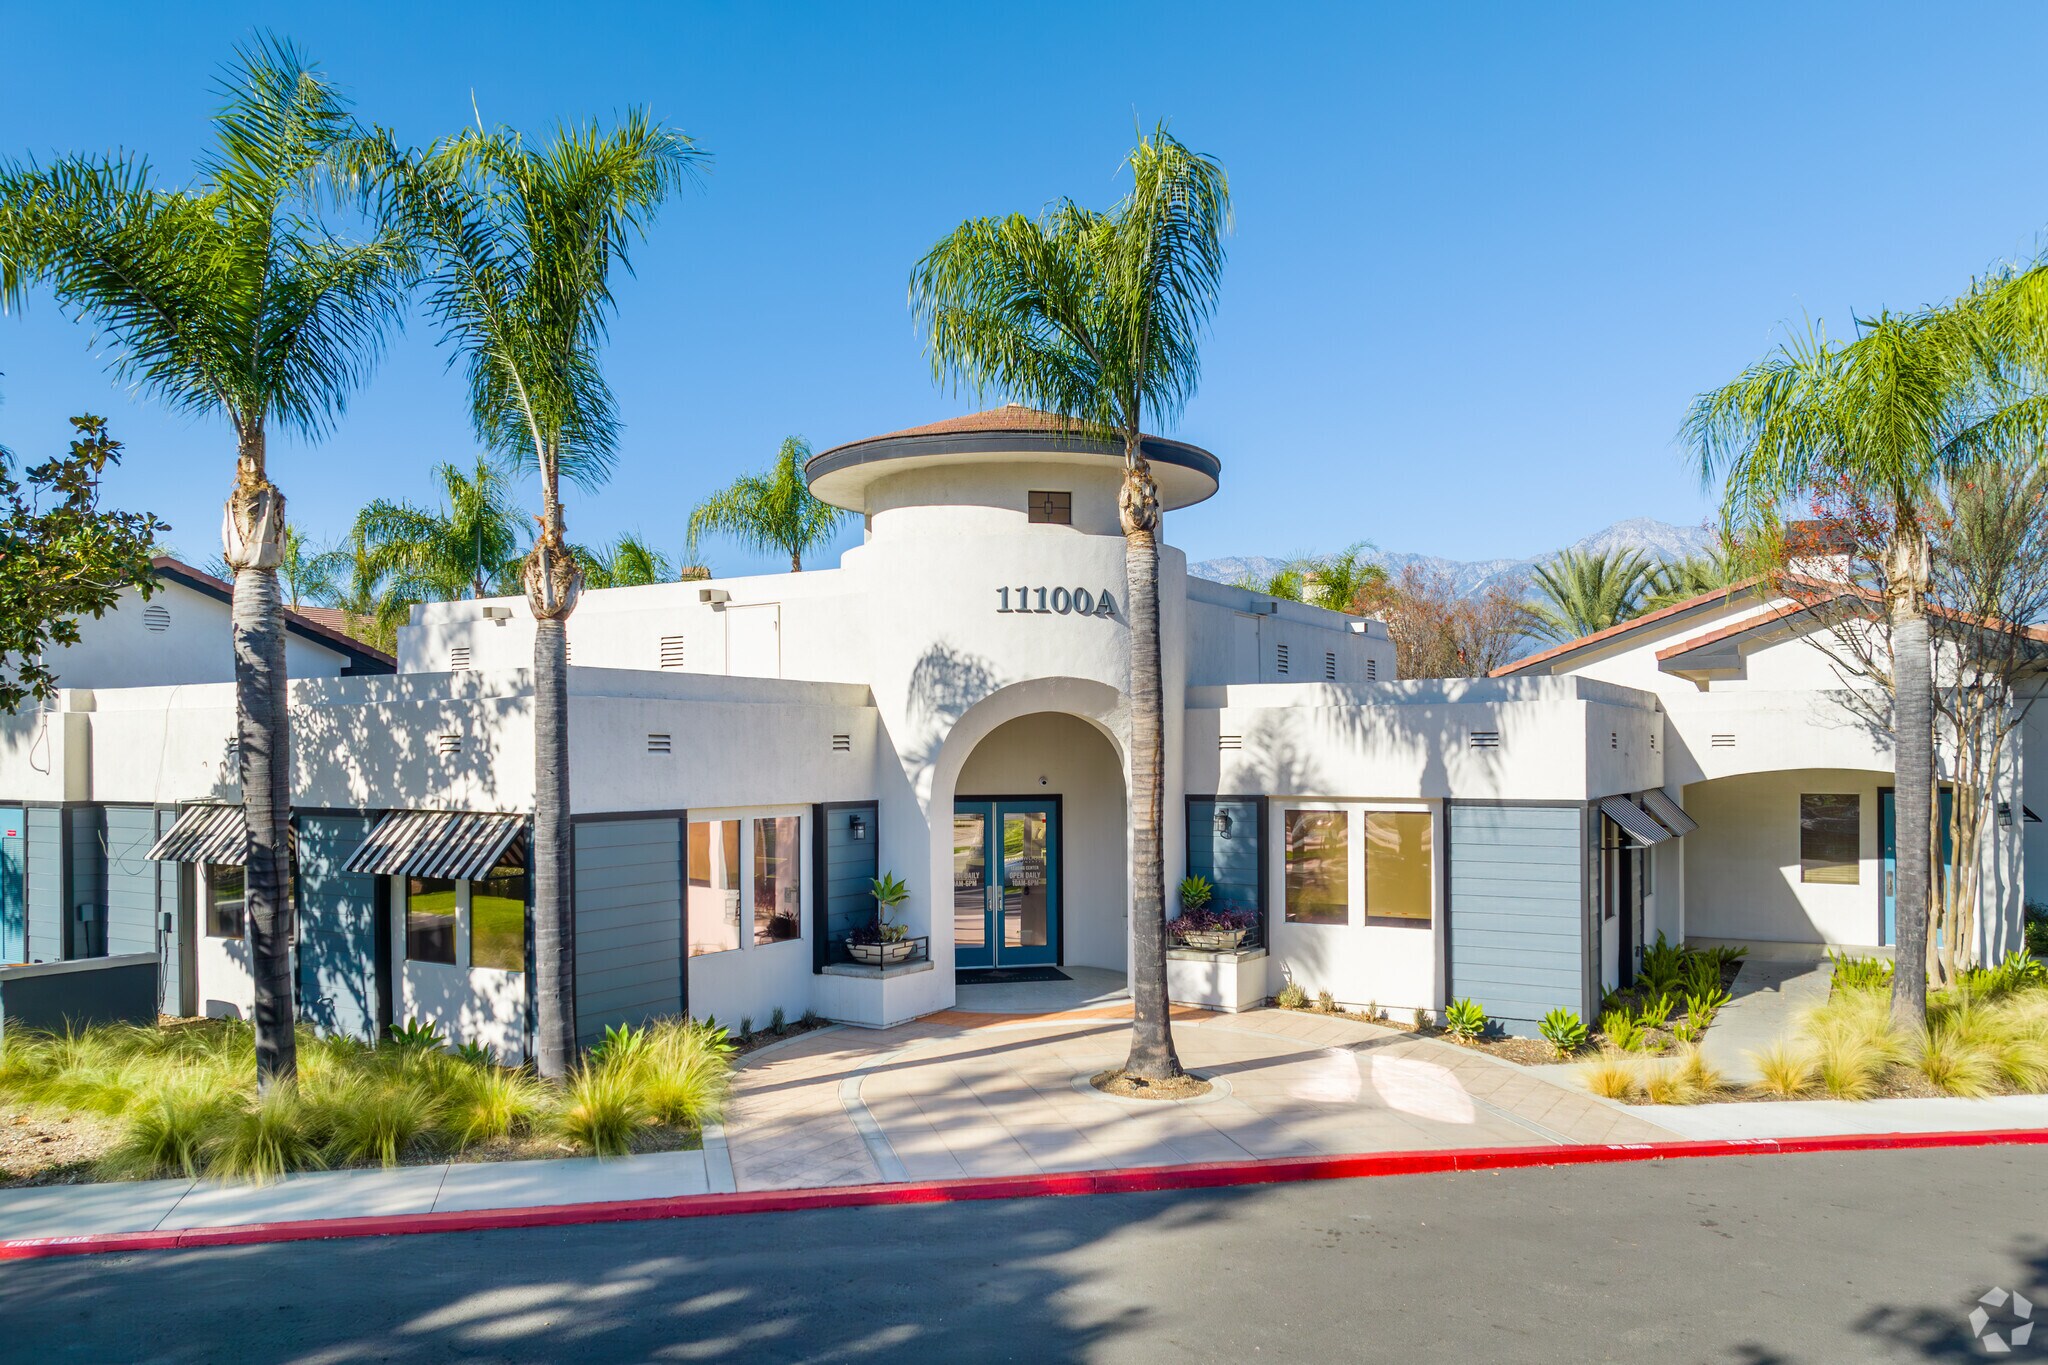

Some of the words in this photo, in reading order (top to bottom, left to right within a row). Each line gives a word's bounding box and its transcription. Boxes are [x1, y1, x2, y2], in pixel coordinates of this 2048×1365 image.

[996, 585, 1115, 614] 11100A
[5, 1239, 45, 1247] FIRE
[49, 1236, 90, 1245] LANE
